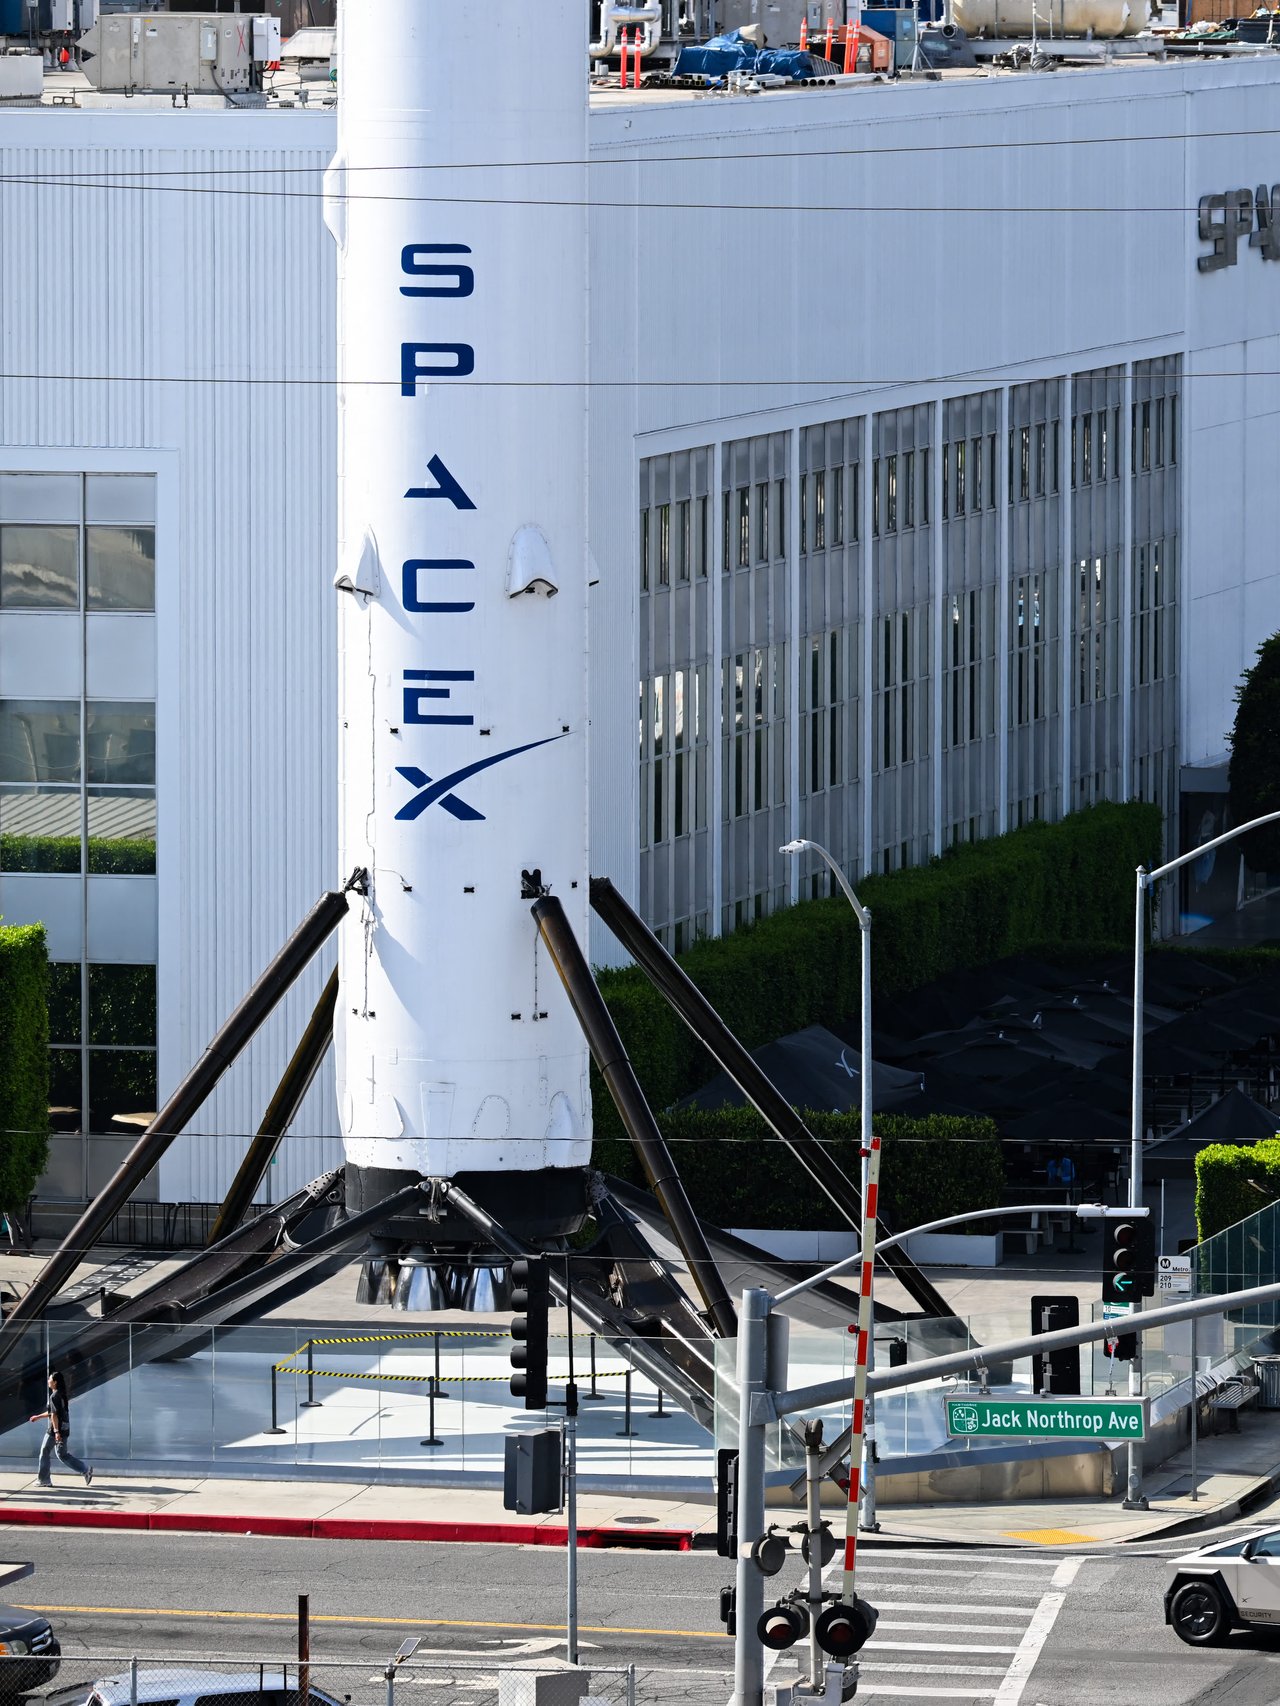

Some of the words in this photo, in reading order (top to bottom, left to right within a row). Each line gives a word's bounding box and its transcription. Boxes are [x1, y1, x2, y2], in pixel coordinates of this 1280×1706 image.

[395, 243, 570, 821] SPACEX
[982, 1409, 1022, 1428] Jack
[1027, 1410, 1103, 1433] Northrop
[1108, 1411, 1139, 1430] Ave
[1240, 1610, 1272, 1618] SECURITY
